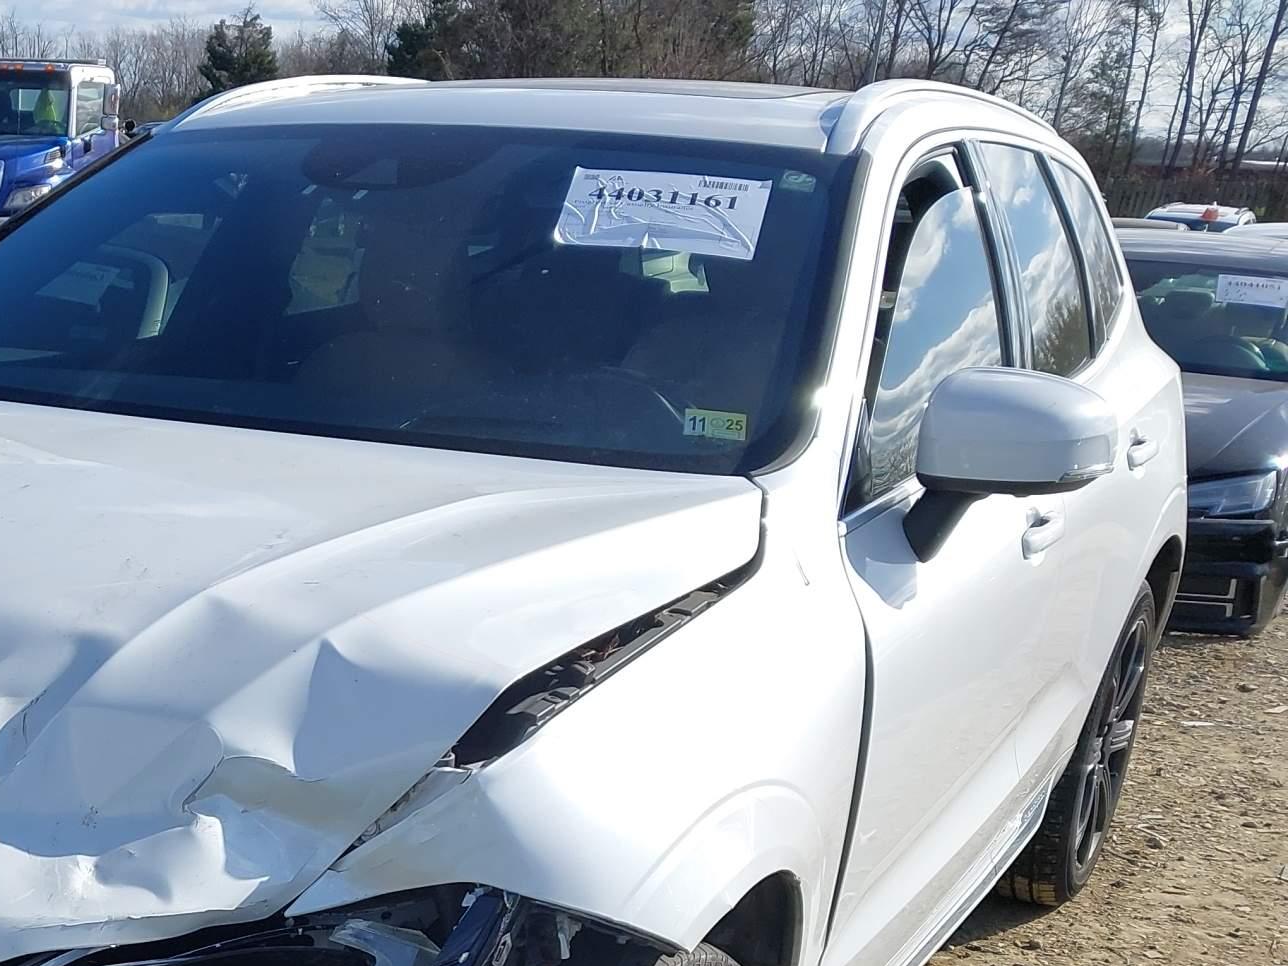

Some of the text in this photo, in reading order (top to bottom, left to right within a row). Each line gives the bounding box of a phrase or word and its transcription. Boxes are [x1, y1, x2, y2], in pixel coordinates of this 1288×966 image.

[588, 186, 738, 210] 44031161
[689, 416, 743, 432] 11 25
